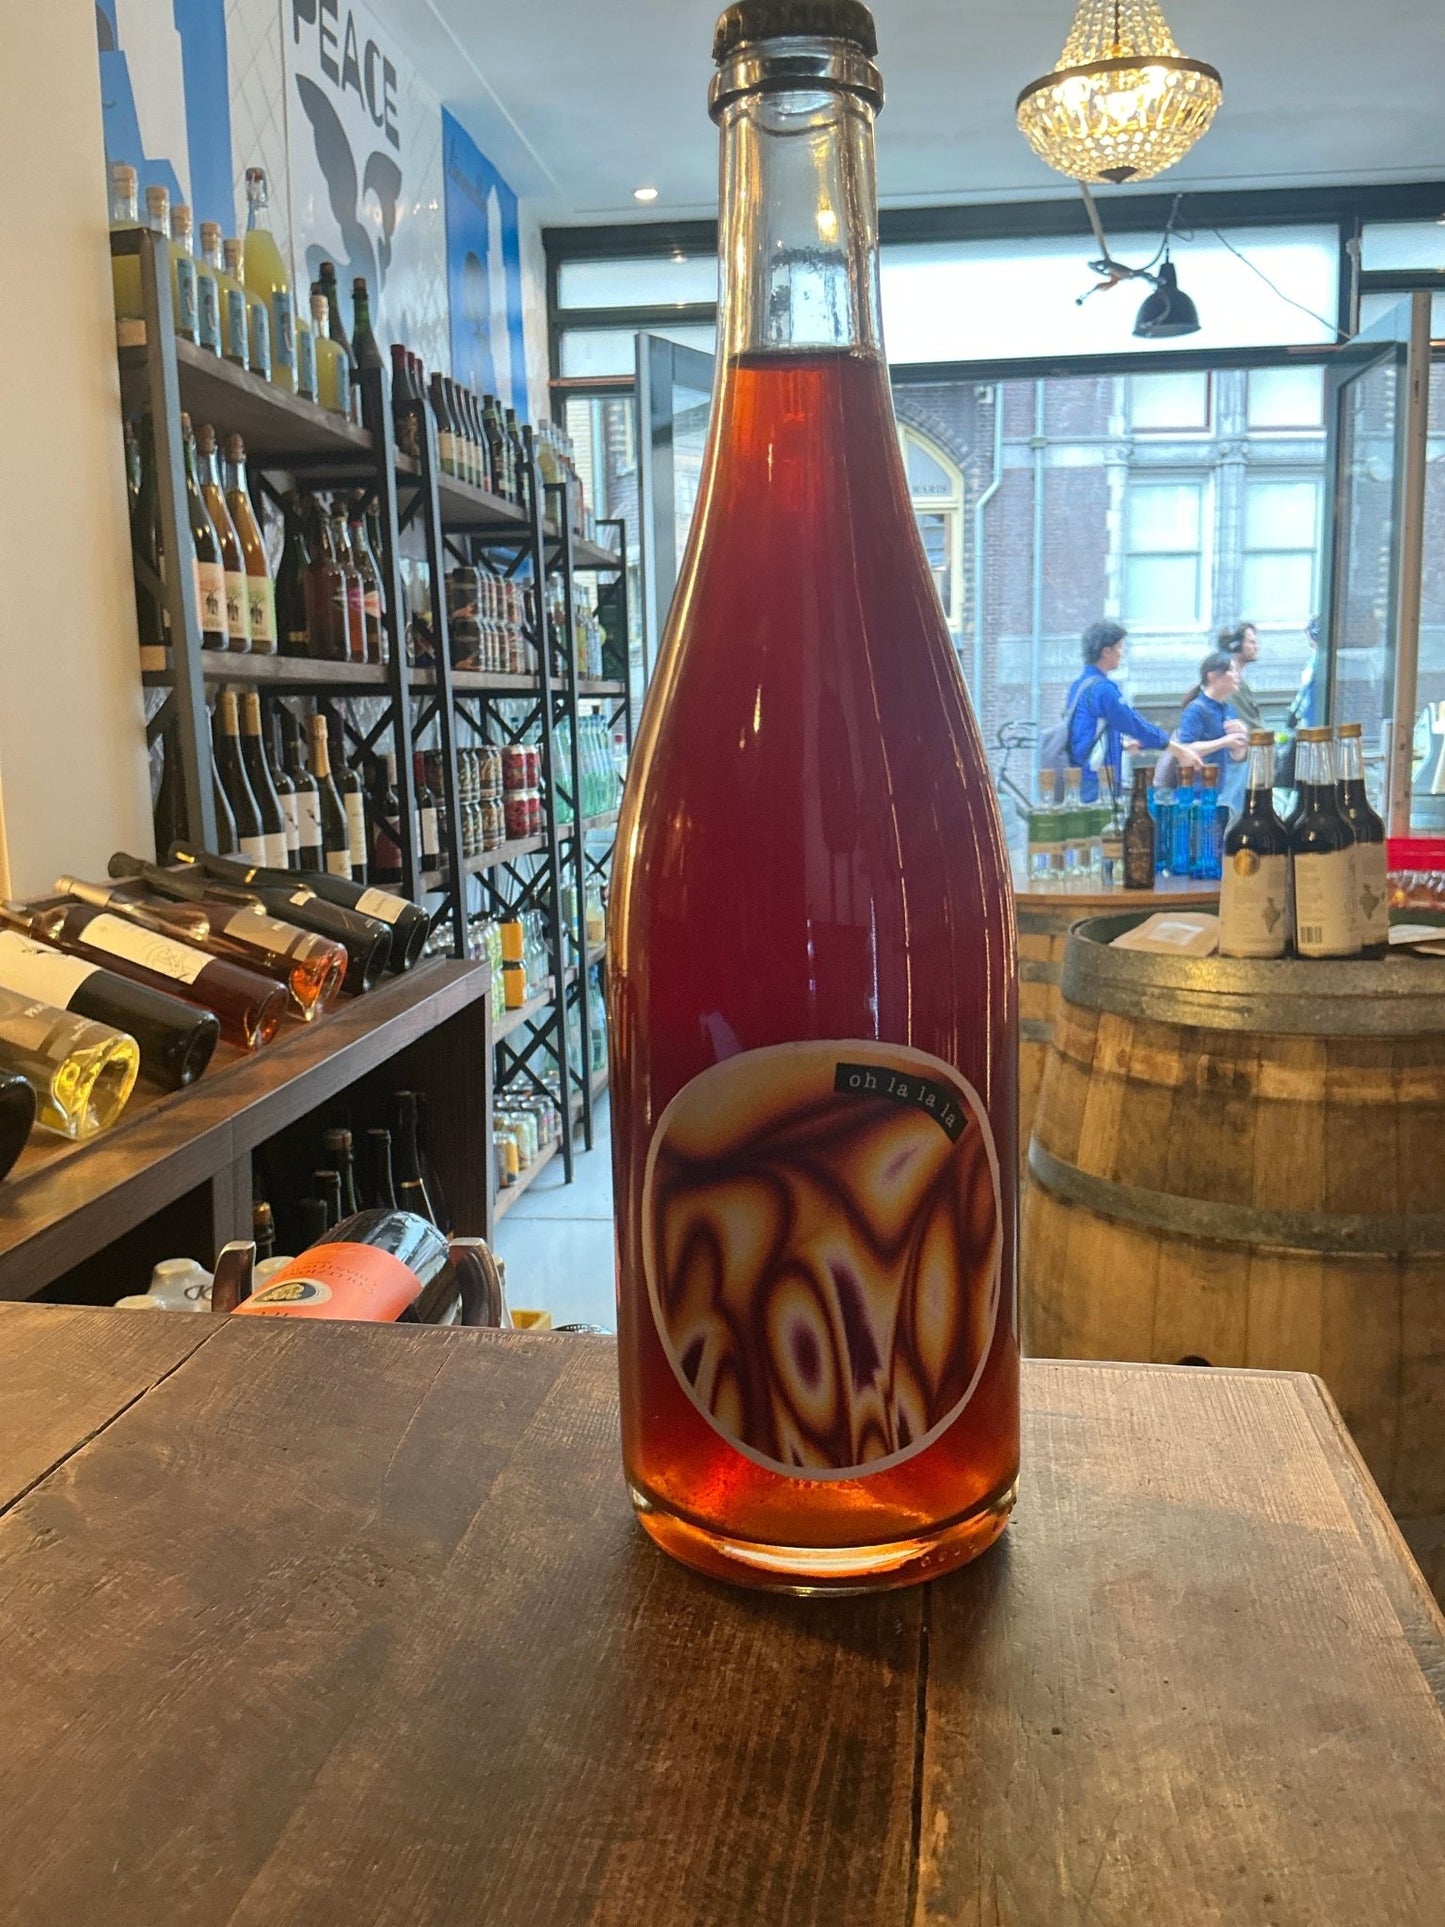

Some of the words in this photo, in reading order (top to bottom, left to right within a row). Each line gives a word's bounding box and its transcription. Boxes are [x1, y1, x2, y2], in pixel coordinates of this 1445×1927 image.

[849, 1072, 877, 1088] oh
[887, 1077, 908, 1098] la
[918, 1086, 937, 1108] la
[940, 1103, 956, 1128] la
